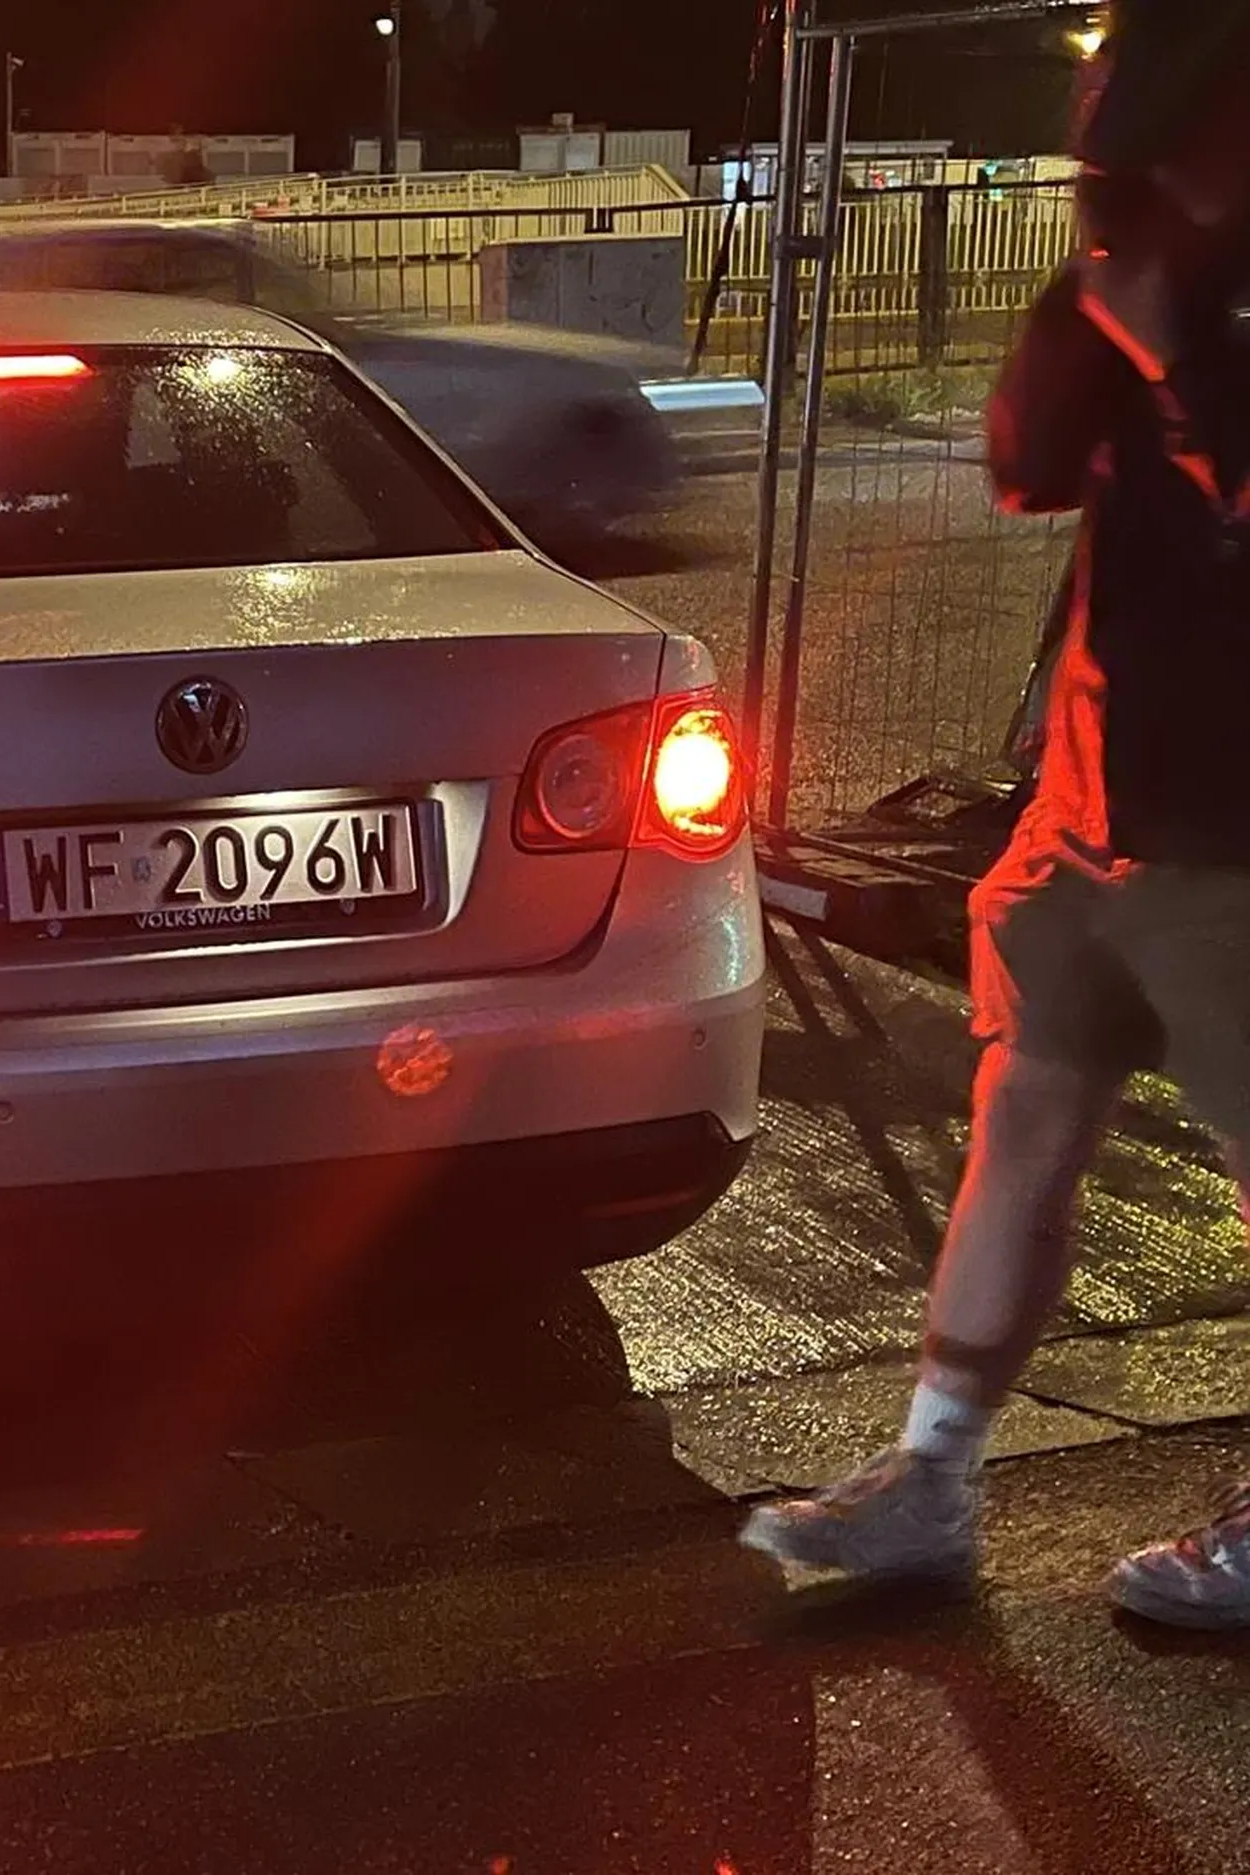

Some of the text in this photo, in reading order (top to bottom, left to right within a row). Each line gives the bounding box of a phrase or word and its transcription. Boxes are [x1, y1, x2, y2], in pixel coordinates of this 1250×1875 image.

[158, 679, 248, 774] VW
[23, 815, 395, 914] WF 2096W
[136, 904, 272, 930] VOLKSWAGEN
